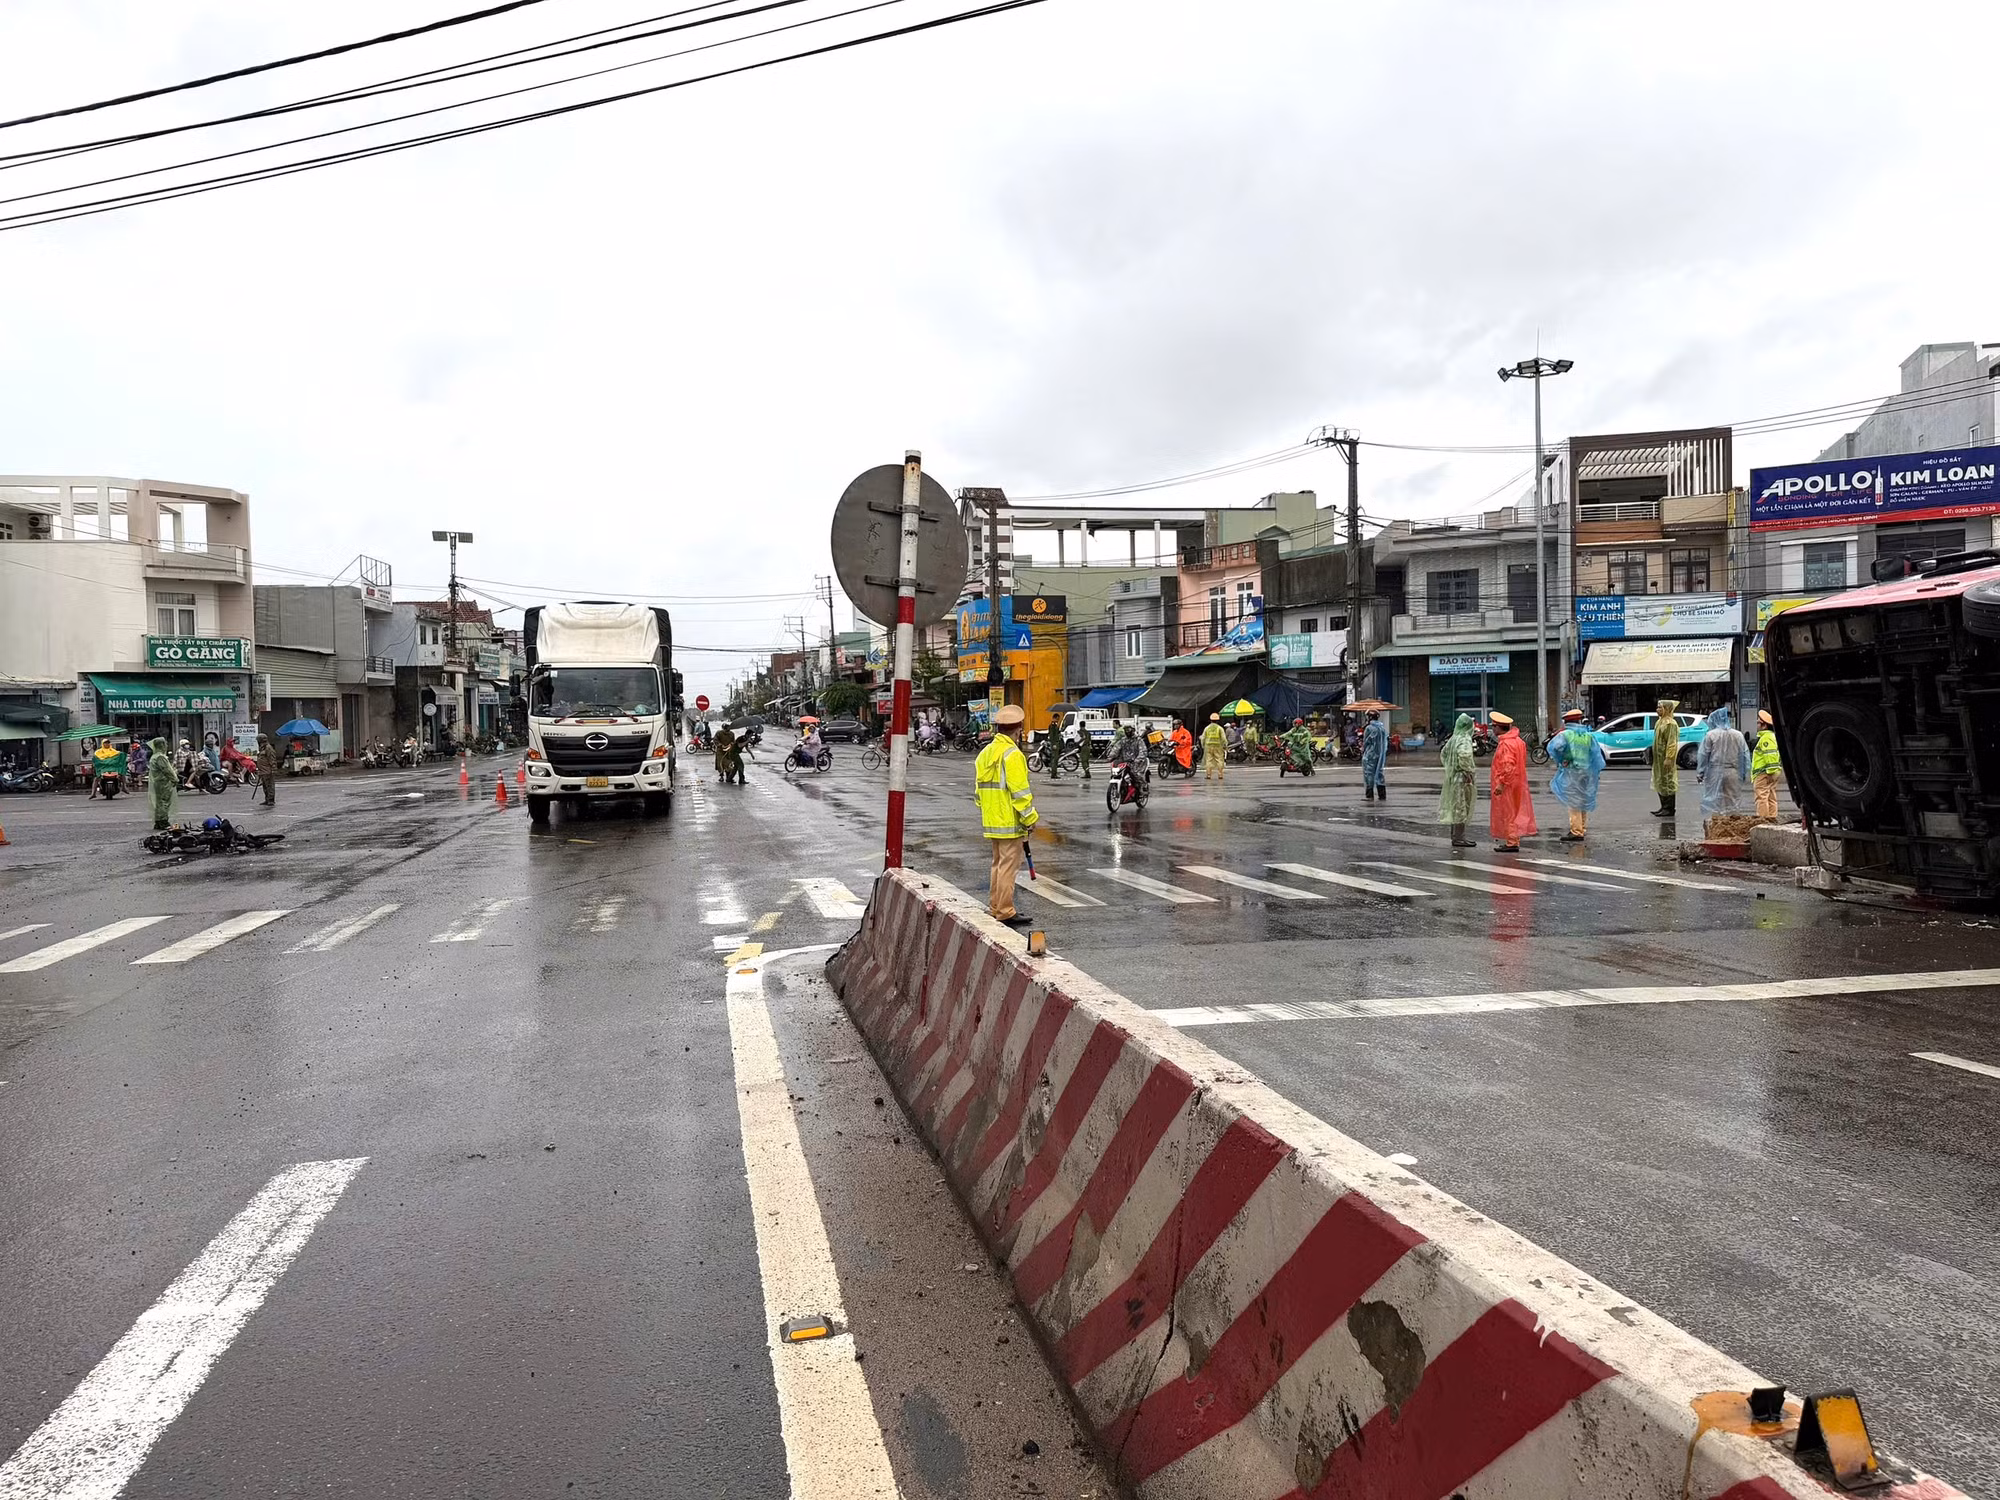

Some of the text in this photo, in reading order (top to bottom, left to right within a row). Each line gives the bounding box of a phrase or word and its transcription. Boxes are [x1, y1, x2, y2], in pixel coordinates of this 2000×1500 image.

[1891, 464, 1994, 486] KIM LOAN
[1756, 471, 1872, 503] APOLLO
[1778, 494, 1817, 502] BONDING
[1814, 501, 1827, 509] MỘT
[1600, 603, 1621, 611] ANH
[156, 645, 236, 659] GÒ GĂNG
[1461, 655, 1498, 663] NGUYÊN
[109, 696, 233, 708] NHÀ THUỐC GÒ GĂNG
